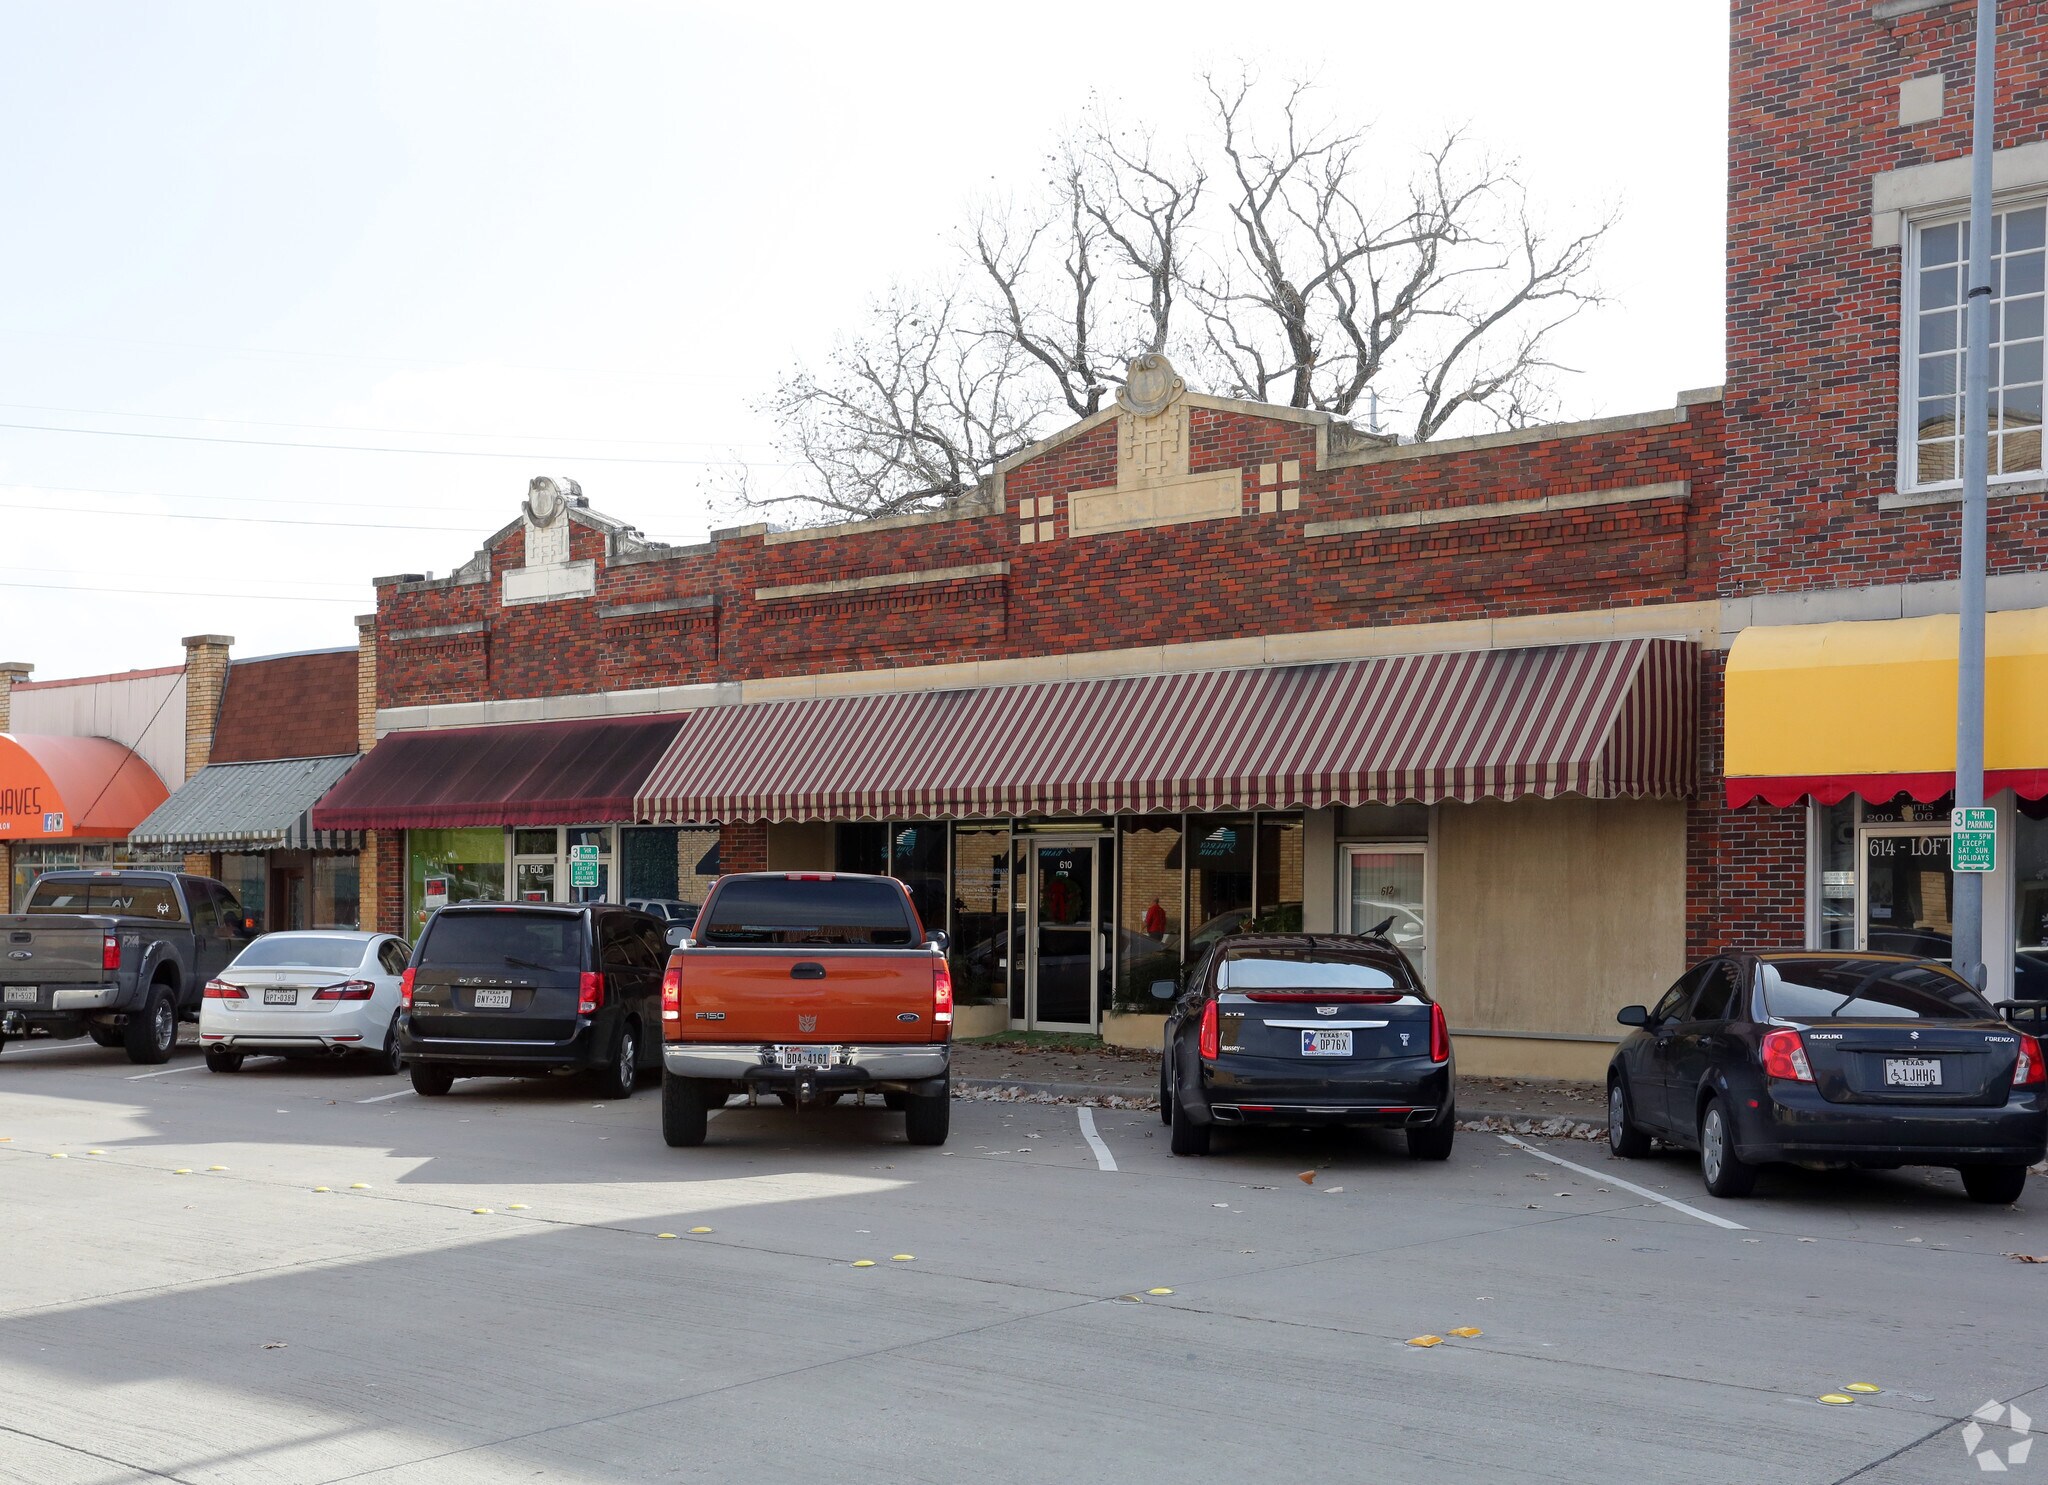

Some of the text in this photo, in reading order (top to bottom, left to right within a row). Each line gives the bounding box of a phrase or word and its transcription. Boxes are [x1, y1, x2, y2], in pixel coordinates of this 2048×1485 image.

[1954, 811, 1963, 827] 3
[1973, 811, 1985, 819] HR
[1967, 821, 1994, 829] PARKING
[573, 848, 579, 858] 3
[1869, 839, 1896, 857] 614
[530, 865, 544, 874] 606
[1059, 861, 1073, 869] 610
[1381, 886, 1394, 896] 612
[1320, 1039, 1347, 1050] DP76X
